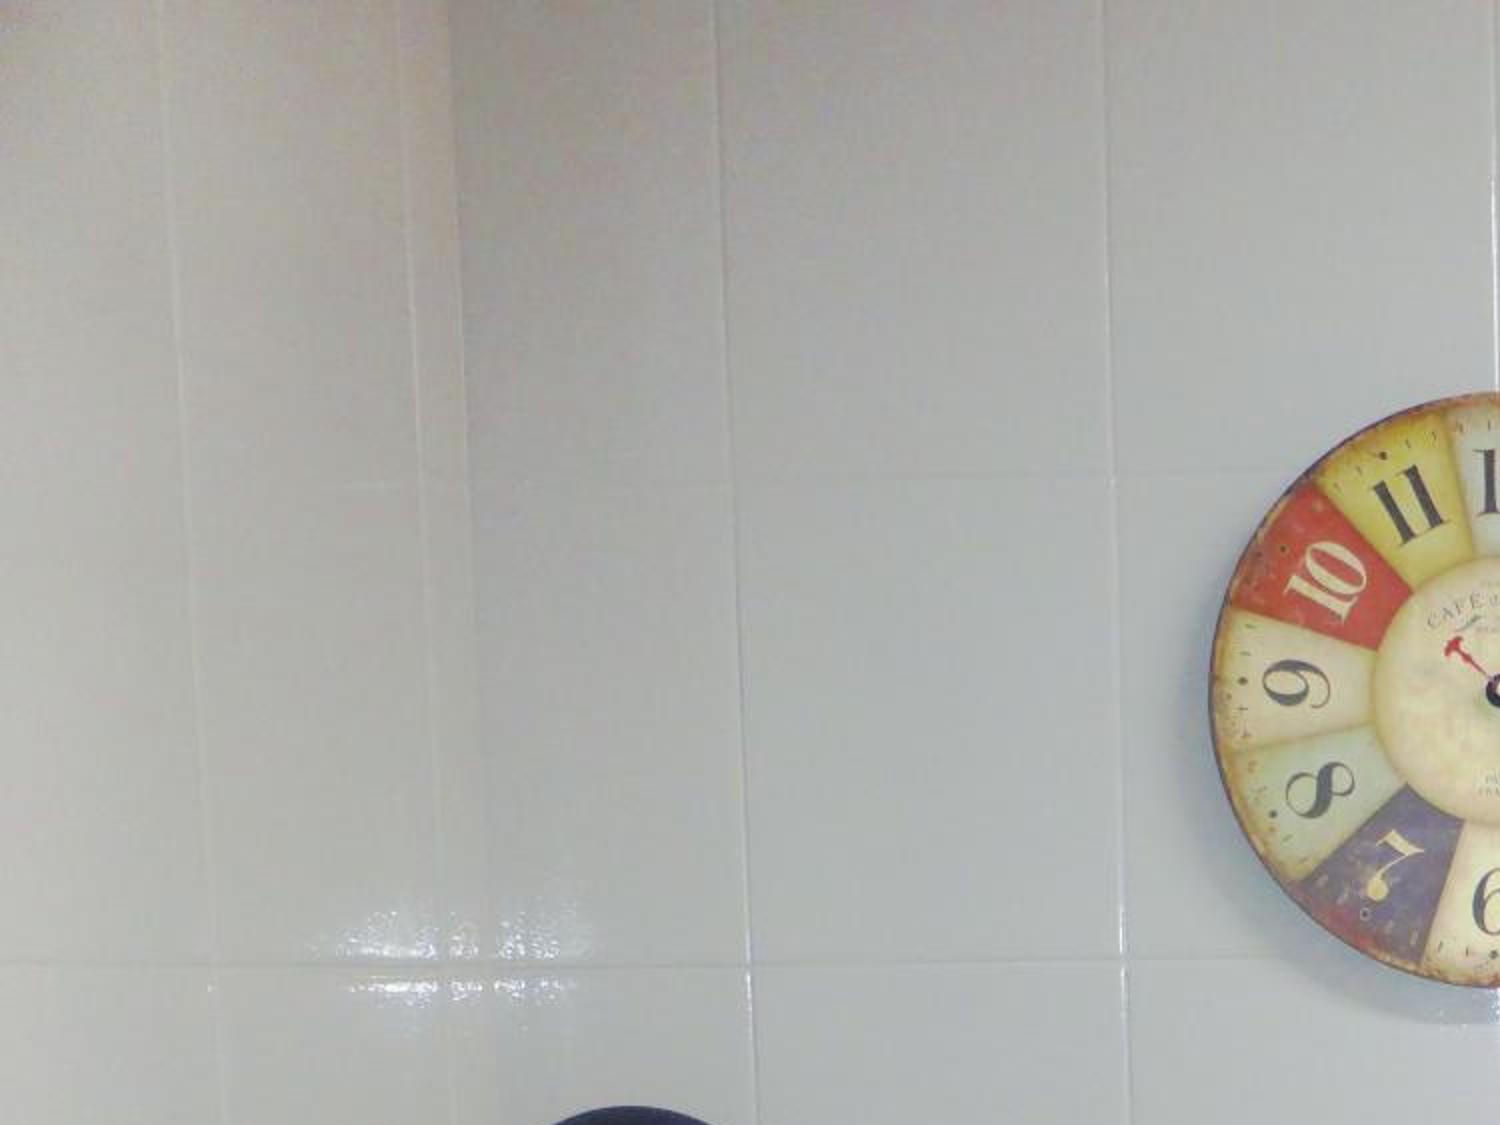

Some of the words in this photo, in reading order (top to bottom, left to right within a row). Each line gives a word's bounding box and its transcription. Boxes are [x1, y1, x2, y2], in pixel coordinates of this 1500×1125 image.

[1372, 463, 1449, 549] 11
[1283, 540, 1368, 622] 10
[1262, 658, 1331, 710] 9
[1285, 761, 1356, 819] 8
[1366, 829, 1426, 901] 7
